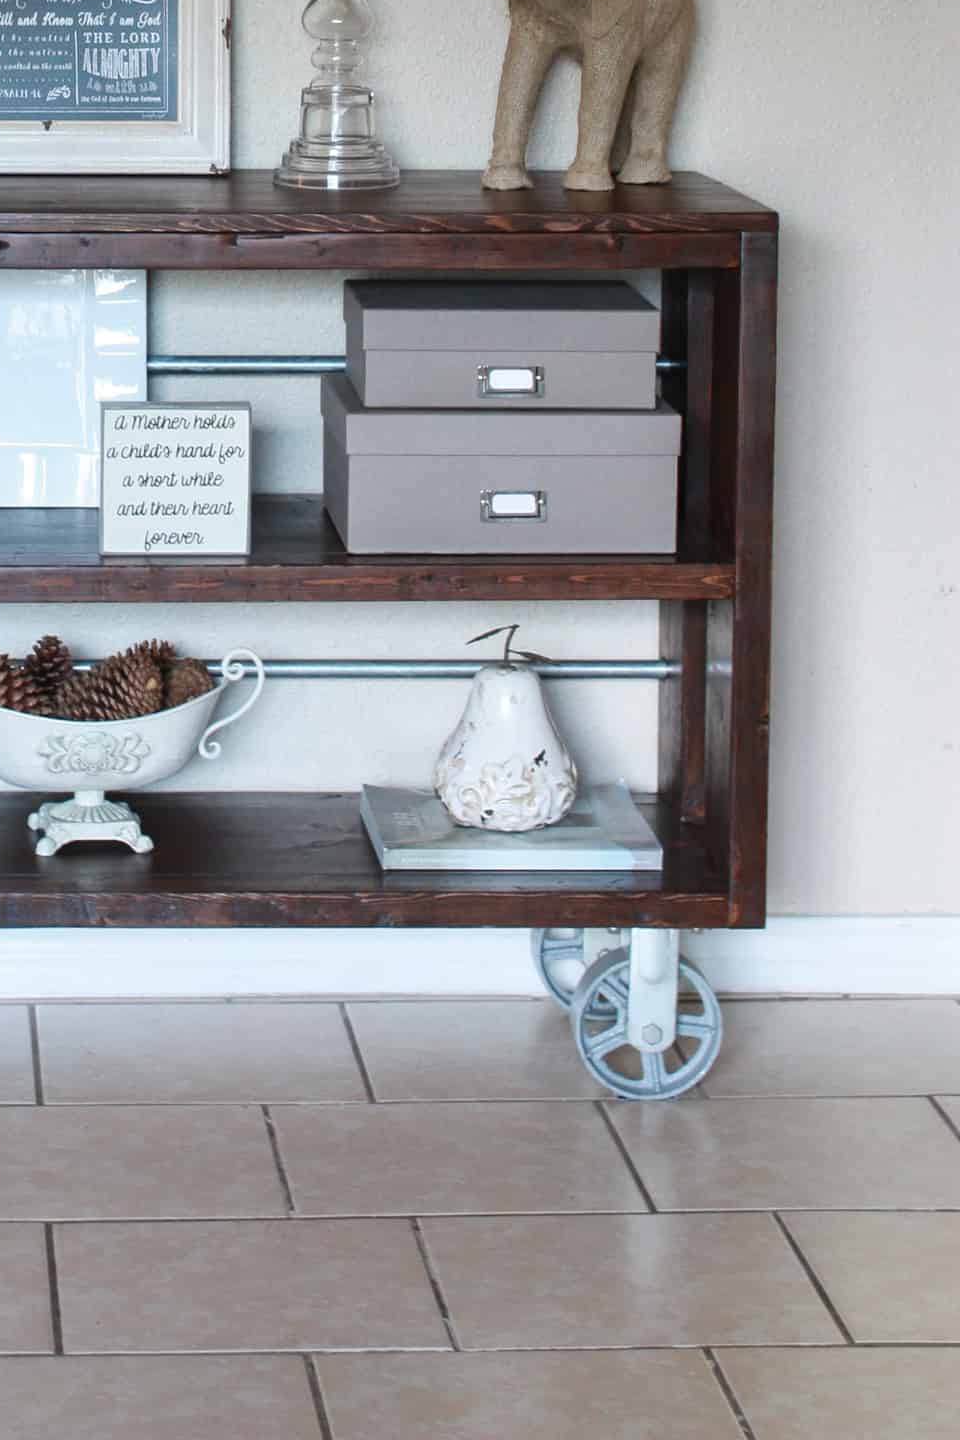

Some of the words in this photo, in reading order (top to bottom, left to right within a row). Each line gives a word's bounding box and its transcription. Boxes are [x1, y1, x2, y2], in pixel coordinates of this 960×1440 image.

[17, 12, 37, 25] and
[42, 12, 73, 26] Know
[78, 12, 106, 26] That
[108, 12, 115, 25] I
[120, 16, 134, 26] am
[137, 11, 161, 28] God
[83, 32, 113, 43] THE
[121, 32, 160, 43] LORD
[83, 48, 160, 79] ALMIGHTY
[132, 415, 190, 430] Mother
[193, 415, 236, 429] holds
[107, 447, 118, 458] a
[121, 443, 171, 458] child's
[176, 443, 216, 458] hand
[218, 443, 245, 464] for
[123, 476, 134, 487] a
[138, 472, 177, 487] short
[181, 472, 224, 487] while
[117, 502, 147, 516] and
[150, 502, 188, 516] their
[192, 501, 234, 515] heart
